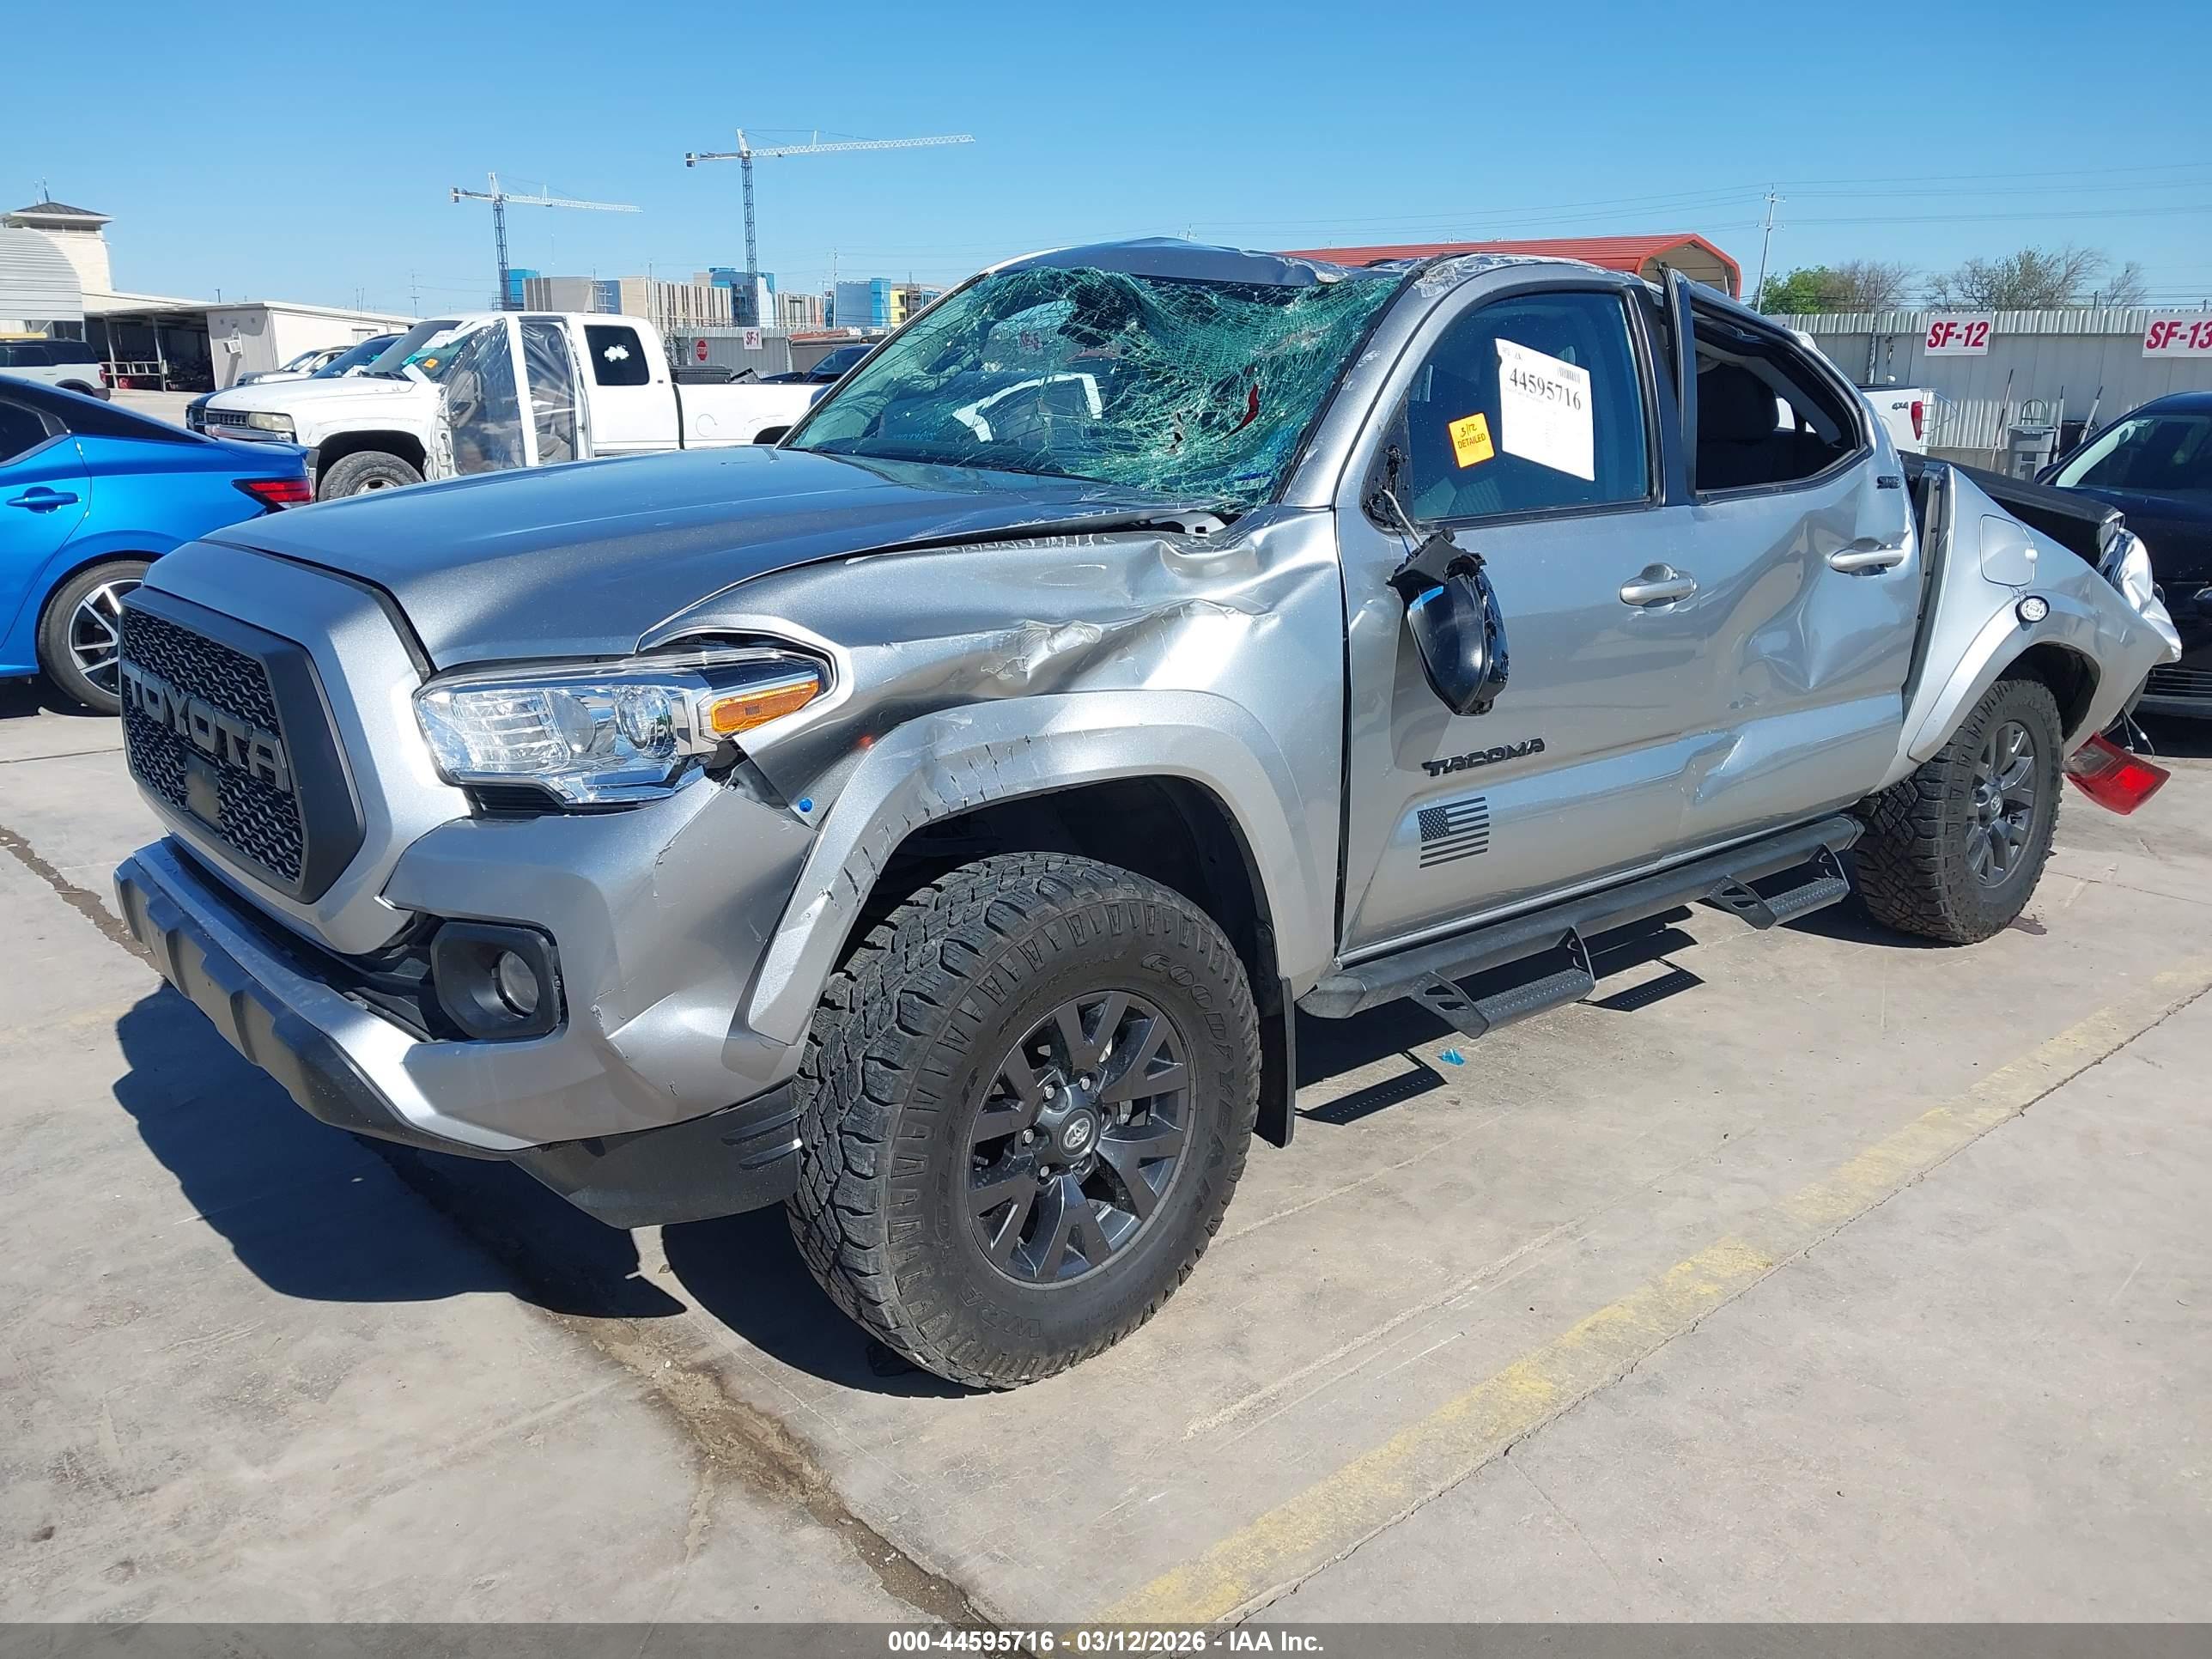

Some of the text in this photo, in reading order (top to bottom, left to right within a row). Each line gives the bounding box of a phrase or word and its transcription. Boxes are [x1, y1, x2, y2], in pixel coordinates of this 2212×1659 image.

[745, 331, 760, 345] SF-1
[1927, 321, 1990, 349] SF-12
[2146, 320, 2212, 349] SF-13
[1509, 368, 1581, 410] 44595716
[1457, 433, 1486, 449] DETAILED
[121, 660, 293, 793] TOYOTA
[1421, 738, 1546, 777] TACOMA
